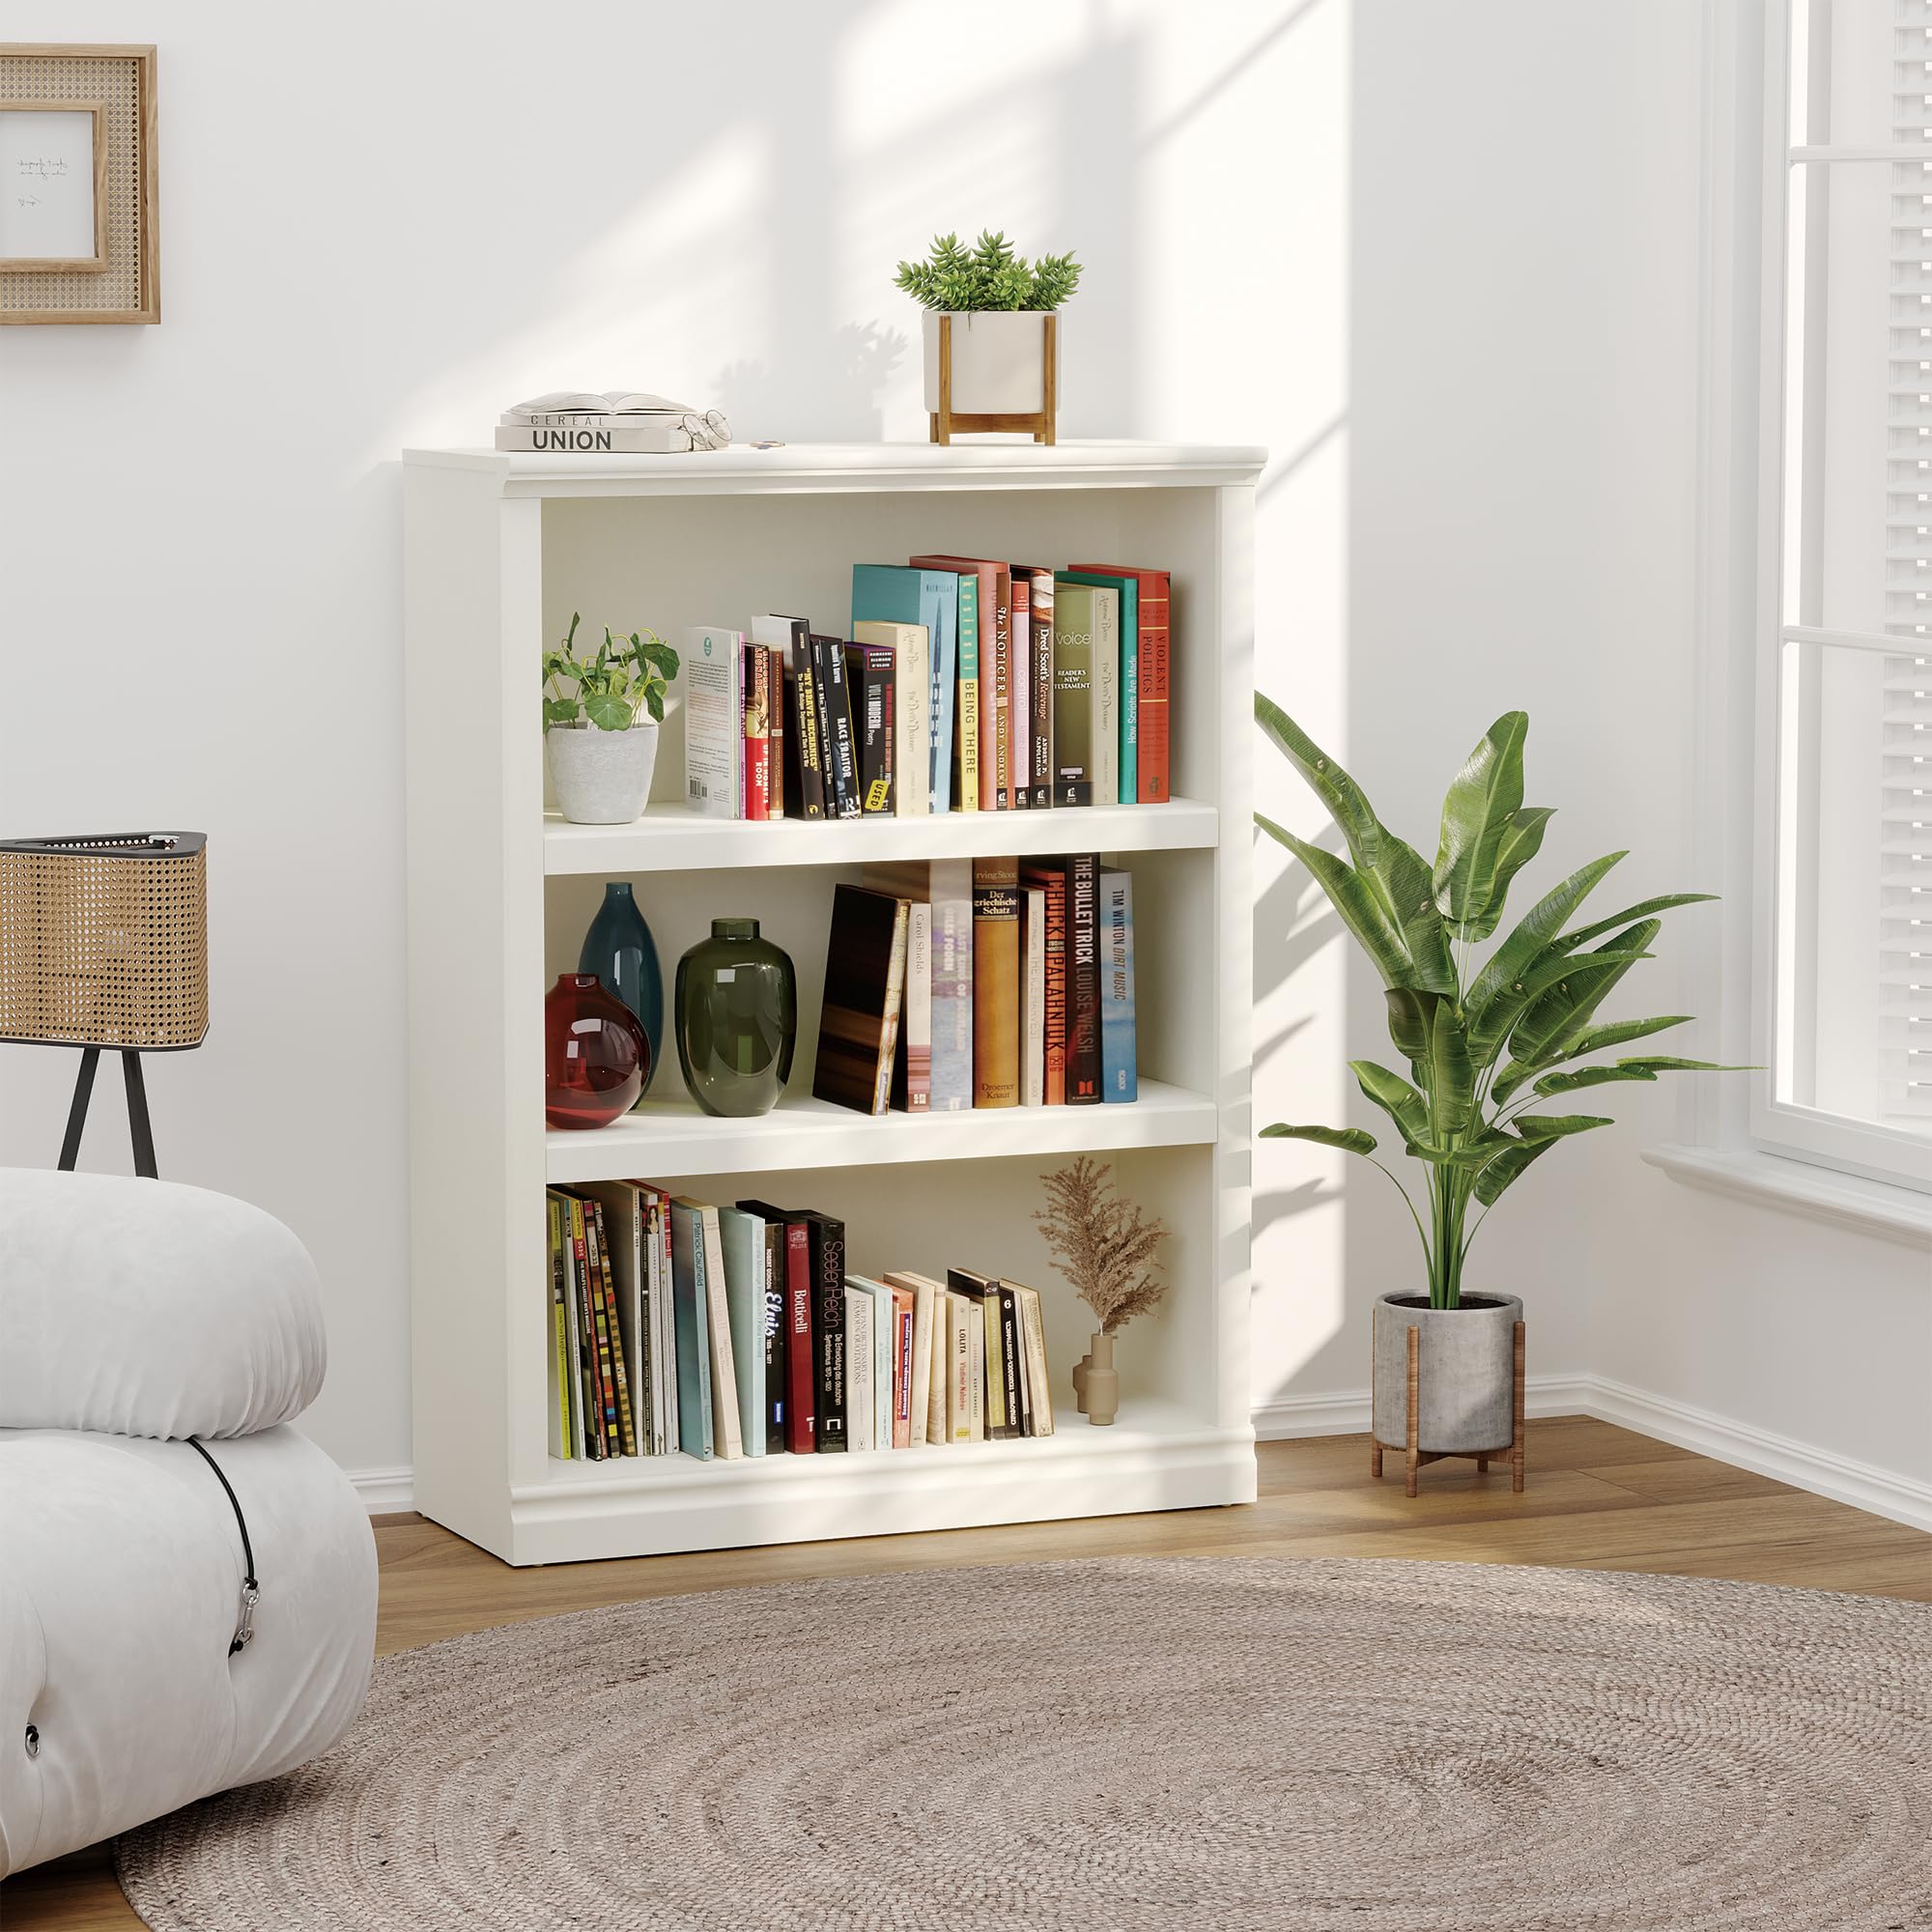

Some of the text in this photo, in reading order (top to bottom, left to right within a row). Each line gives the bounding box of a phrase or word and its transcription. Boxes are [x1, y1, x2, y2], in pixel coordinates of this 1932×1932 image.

[530, 414, 605, 427] CEREAL
[532, 430, 611, 450] UNION
[997, 607, 1008, 691] The NOTICER
[1055, 632, 1092, 645] voice
[754, 648, 763, 693] LEONARD
[1037, 629, 1050, 720] Dred Scott's Revenge
[1142, 636, 1152, 694] POLITICS
[1156, 636, 1166, 693] VIOLENT
[817, 683, 824, 692] If
[818, 694, 825, 705] He
[1127, 655, 1137, 744] How Scripts Are Made
[805, 689, 814, 717] BRAVE
[867, 700, 881, 728] MODERN
[799, 711, 808, 728] Engineers
[965, 682, 976, 774] BEING THERE
[762, 745, 770, 756] UP
[837, 718, 851, 779] RACE TRAITOR
[866, 729, 874, 746] Poetry
[762, 757, 770, 768] IN
[870, 783, 885, 807] USED
[974, 897, 1017, 907] griechische
[982, 906, 1011, 915] Schatz
[1045, 880, 1065, 935] CHUCK
[915, 914, 924, 975] Carol Shields
[1074, 856, 1094, 1054] THE BULLET TRICK LOUISE WELSH
[1113, 890, 1126, 1001] TIM WINTON DIRT MUSIC
[957, 983, 967, 997] OF
[1045, 956, 1065, 1052] PALAHNIUK
[694, 1222, 704, 1287] Patrick Caulfield
[824, 1240, 843, 1328] SeelenReich
[765, 1292, 783, 1337] Elvis
[794, 1290, 808, 1333] Botticelli
[1004, 1299, 1011, 1309] 6
[835, 1371, 843, 1380] des
[835, 1380, 843, 1406] deutschen
